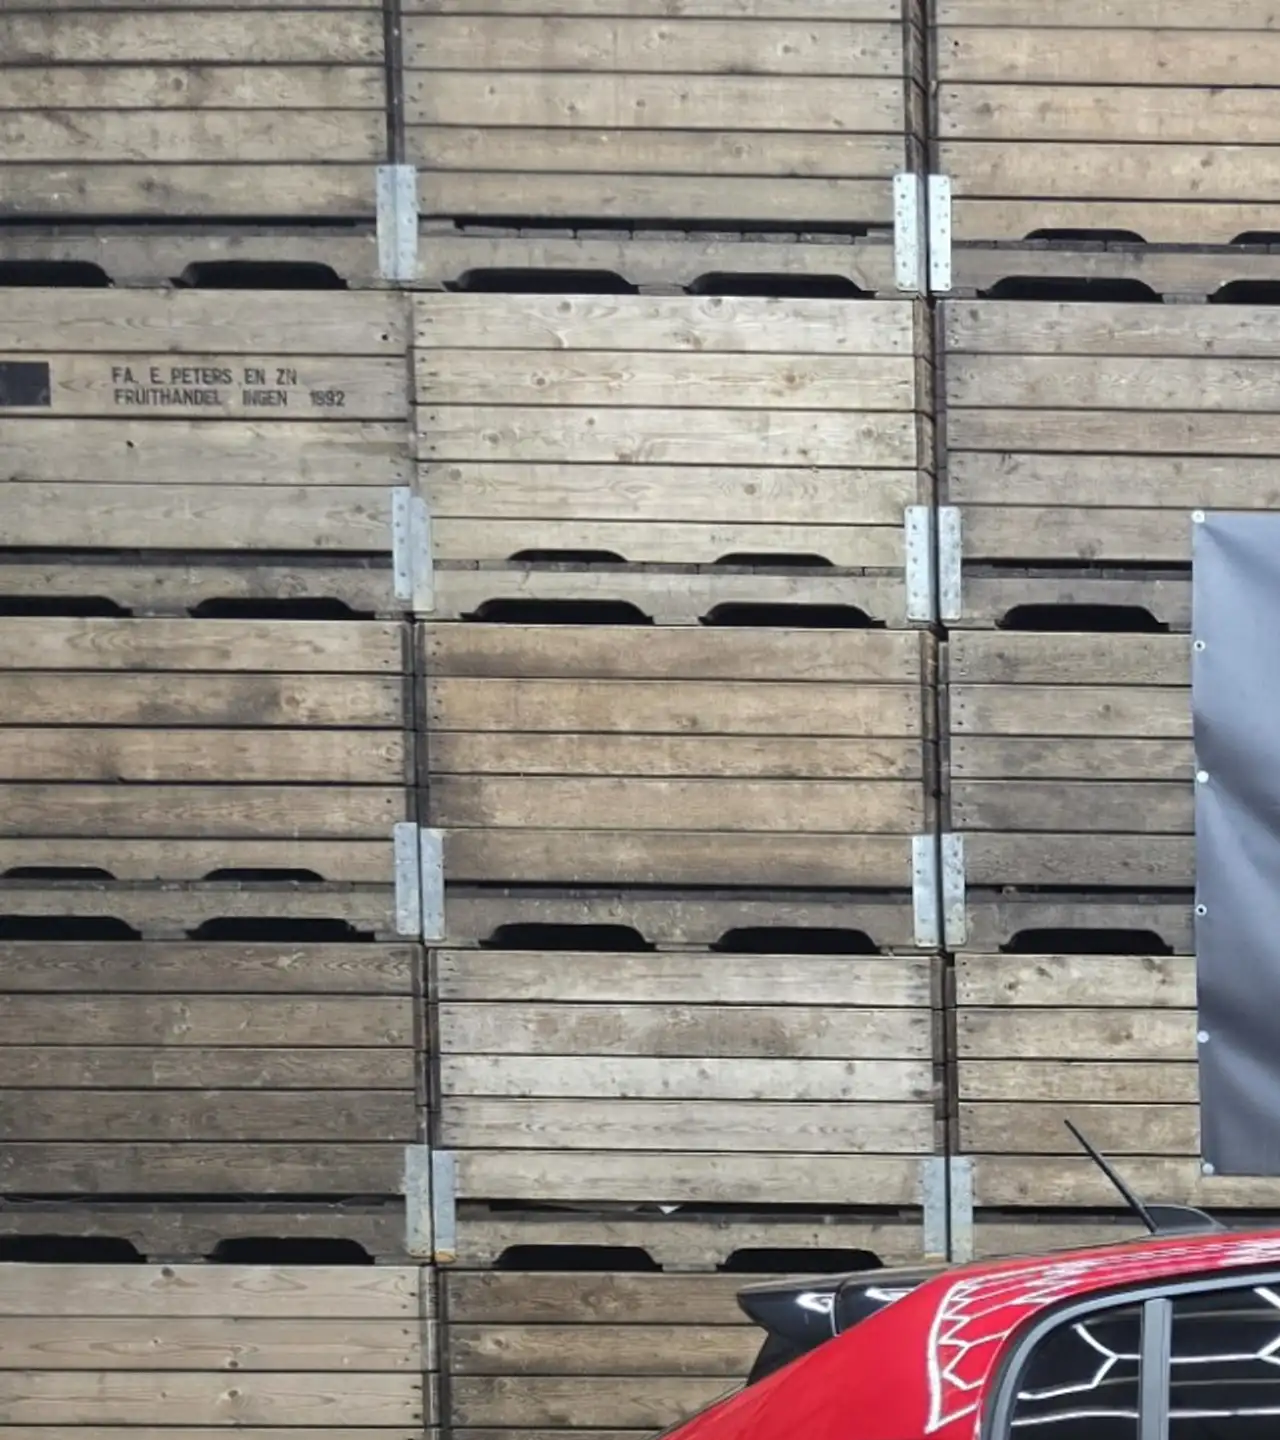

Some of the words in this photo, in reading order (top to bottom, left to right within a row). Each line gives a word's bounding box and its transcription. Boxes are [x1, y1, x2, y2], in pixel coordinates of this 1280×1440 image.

[112, 366, 139, 384] FA.
[170, 367, 232, 385] PETERS
[244, 368, 266, 385] EN
[276, 368, 297, 385] ZN
[114, 387, 222, 406] FRUITHANDEL
[242, 389, 288, 407] INGEN
